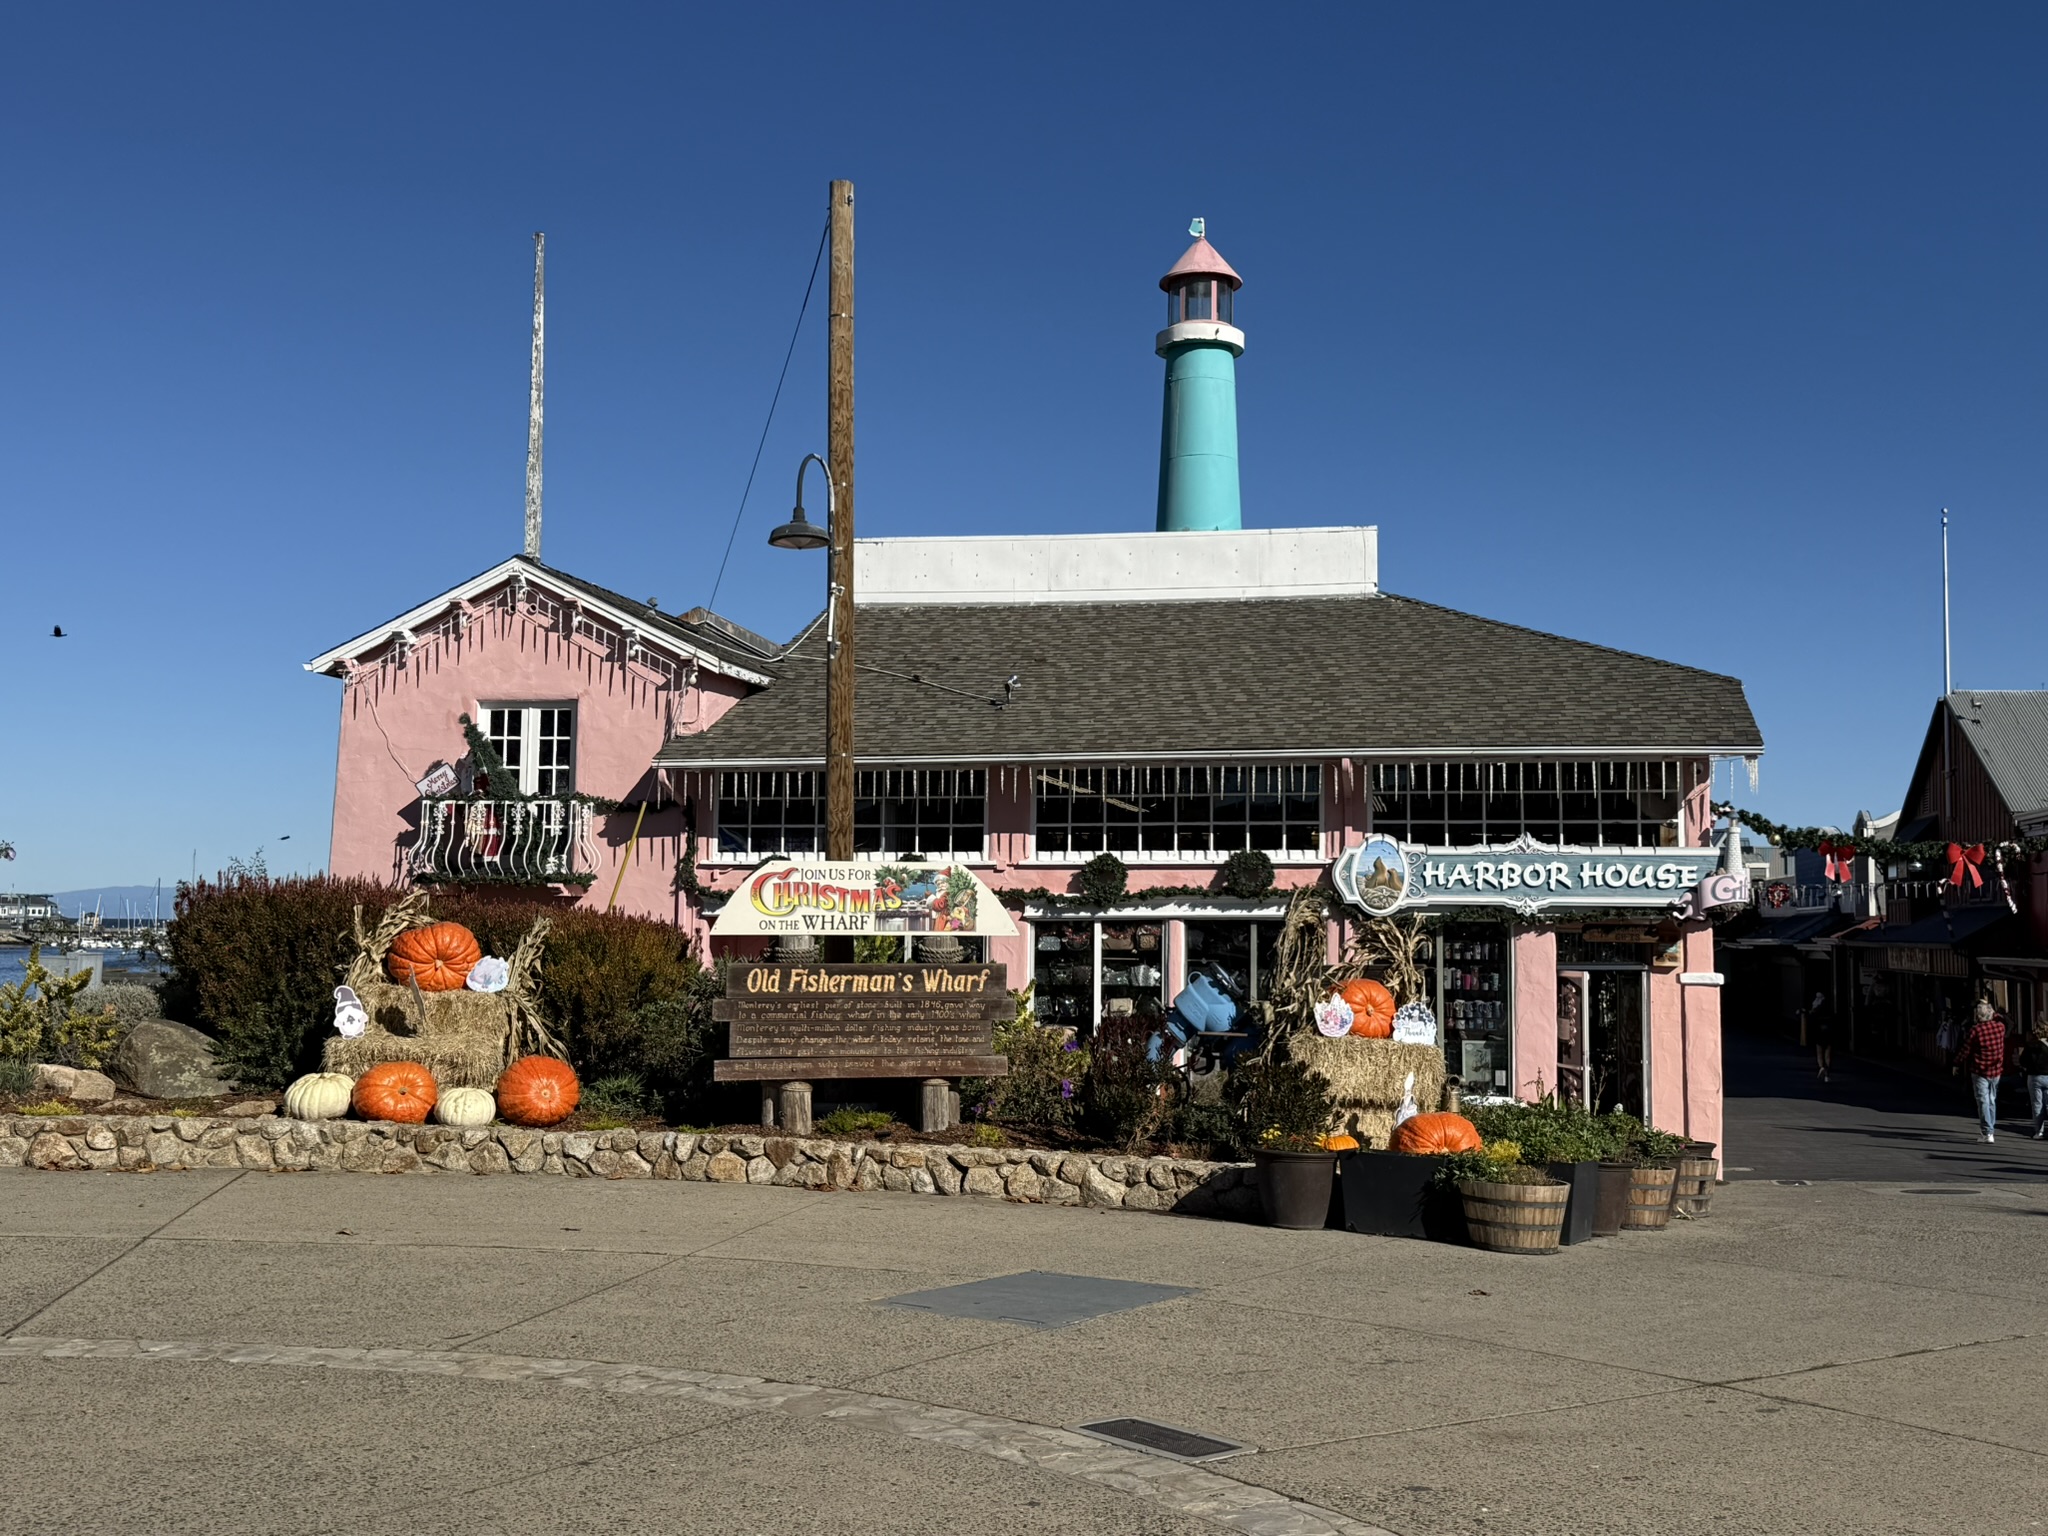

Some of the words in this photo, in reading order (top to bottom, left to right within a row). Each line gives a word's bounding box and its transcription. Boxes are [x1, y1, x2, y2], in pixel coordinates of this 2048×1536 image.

[425, 776, 458, 796] Cristmas
[426, 770, 450, 790] Merry
[800, 868, 826, 881] JOIN
[829, 868, 845, 881] US
[848, 868, 871, 881] FOR
[1423, 860, 1572, 891] HARBOR
[1580, 860, 1698, 891] HOUSE
[750, 867, 903, 917] CHRISTMAS
[759, 920, 776, 930] ON
[778, 920, 799, 930] THE
[801, 914, 870, 930] WHARF
[747, 968, 781, 993] Old
[787, 968, 914, 993] Fisherman's
[921, 968, 991, 993] Wharf
[738, 1001, 781, 1011] Monterey's
[787, 1001, 819, 1010] earliest
[825, 1002, 840, 1010] pier
[844, 1000, 853, 1009] of
[856, 1000, 877, 1009] stone
[944, 1002, 964, 1011] gave
[968, 1002, 986, 1011] way
[739, 1011, 747, 1019] to
[761, 1011, 807, 1019] commercial
[811, 1011, 841, 1020] fishing
[848, 1010, 872, 1019] wharf
[877, 1011, 886, 1019] in
[889, 1010, 902, 1020] the
[905, 1010, 925, 1020] early
[931, 1010, 955, 1019] 1900's
[958, 1010, 981, 1019] when
[737, 1024, 786, 1033] Monterey's
[789, 1023, 841, 1032] multi-million
[844, 1023, 867, 1032] dollar
[872, 1023, 901, 1034] fishing
[907, 1023, 941, 1032] industry
[736, 1035, 768, 1045] Despite
[773, 1037, 796, 1045] many
[800, 1036, 832, 1045] changes
[835, 1035, 847, 1043] the
[852, 1035, 876, 1043] wharf
[880, 1034, 903, 1045] today
[908, 1035, 936, 1043] retains
[939, 1034, 952, 1043] the
[972, 1035, 985, 1043] and
[765, 1047, 773, 1055] of
[779, 1047, 793, 1055] the
[840, 1047, 878, 1055] monument
[884, 1046, 892, 1054] to
[819, 1060, 838, 1068] who
[882, 1059, 895, 1067] the
